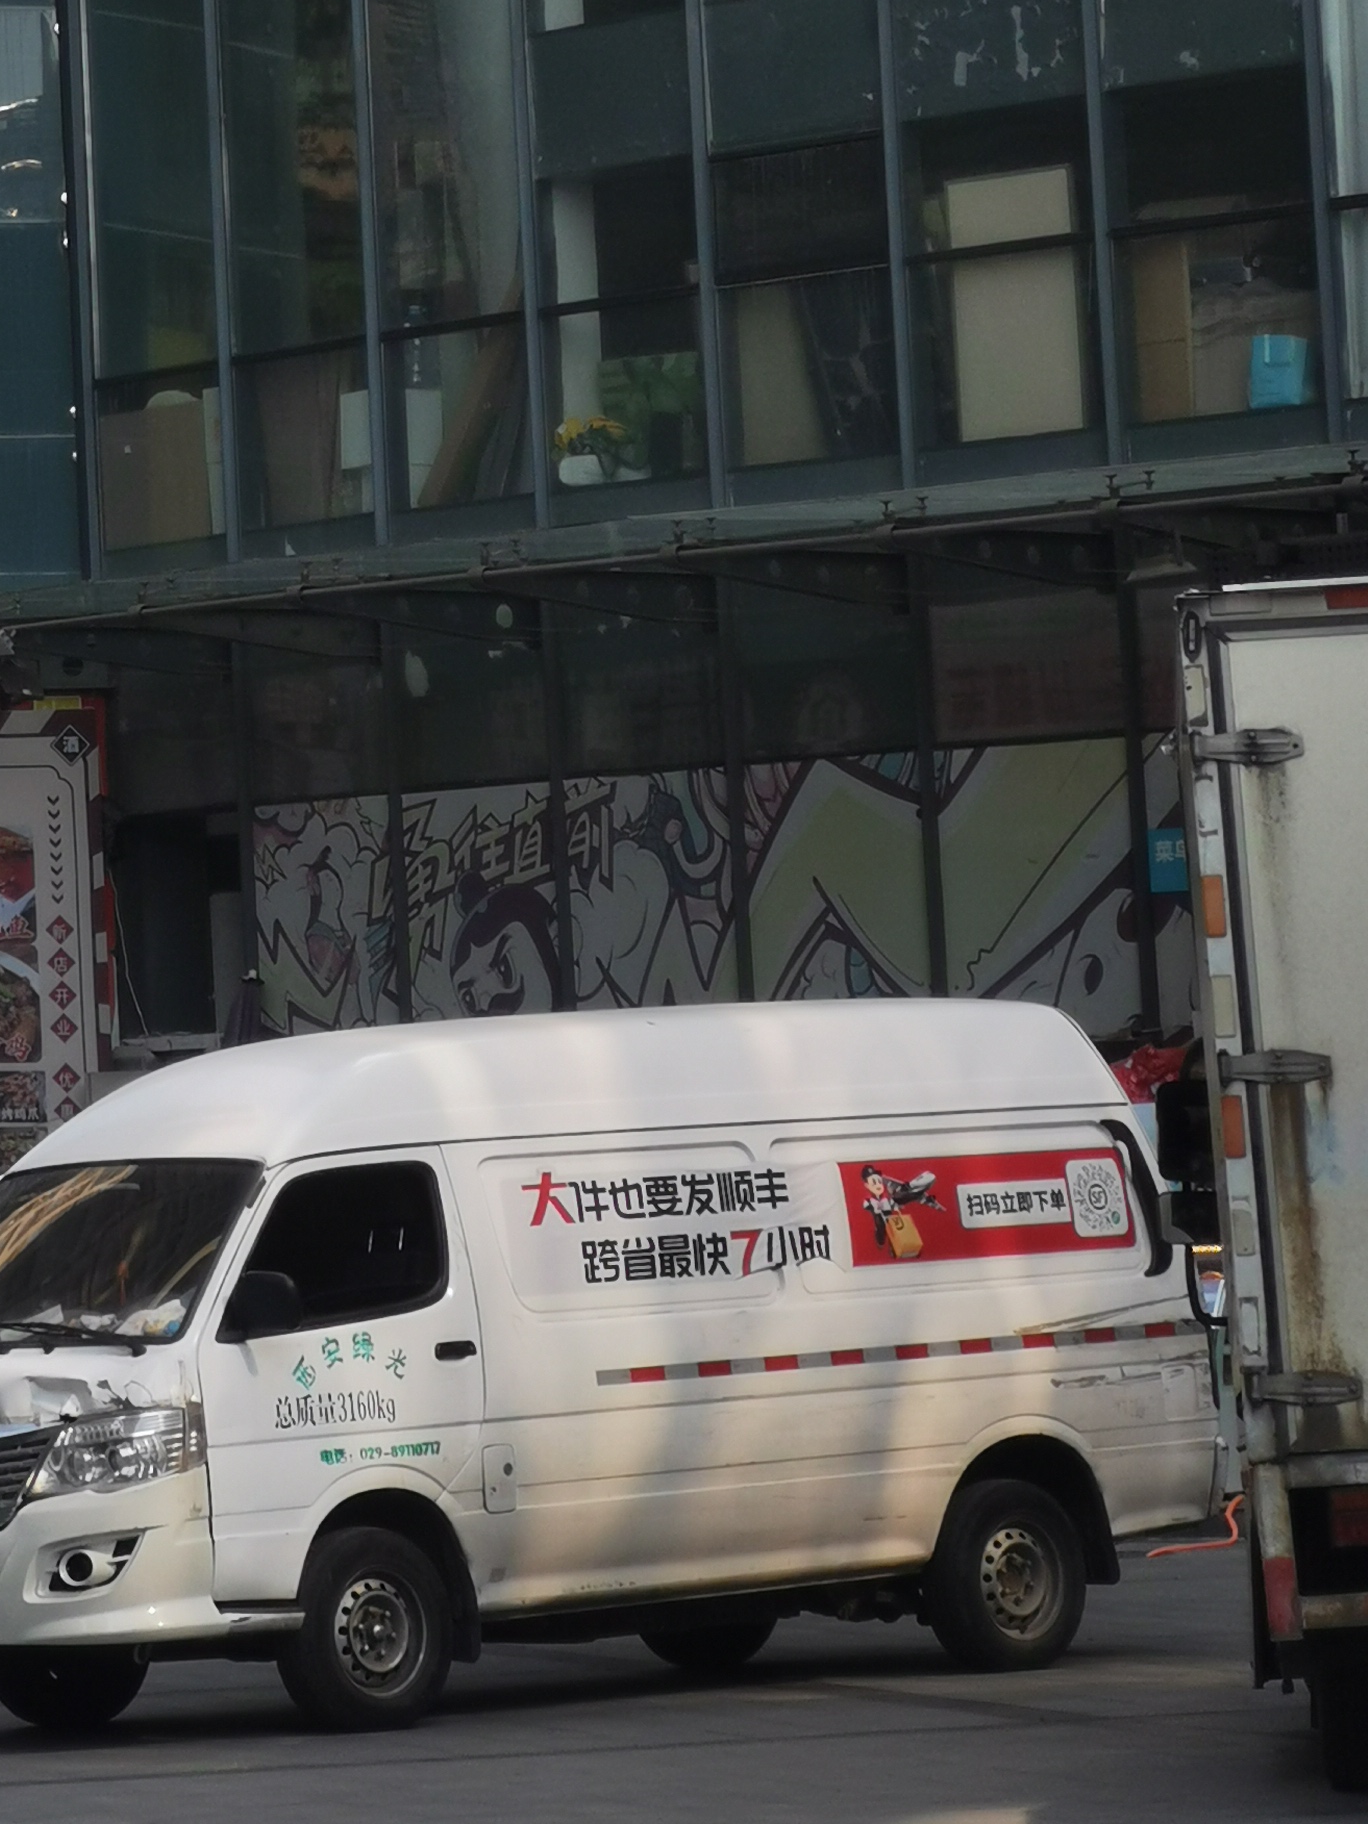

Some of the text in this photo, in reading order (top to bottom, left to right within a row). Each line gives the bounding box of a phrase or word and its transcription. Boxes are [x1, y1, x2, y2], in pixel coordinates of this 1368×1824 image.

[60, 734, 81, 755] 酒
[52, 924, 71, 1036] 新店开业
[522, 1169, 790, 1227] 大件也要发顺丰
[966, 1188, 1067, 1217] 扫码立即下单
[581, 1224, 830, 1283] 跨省最快7小时
[292, 1331, 408, 1390] 西安绿光
[275, 1389, 397, 1429] 总质量3160kg
